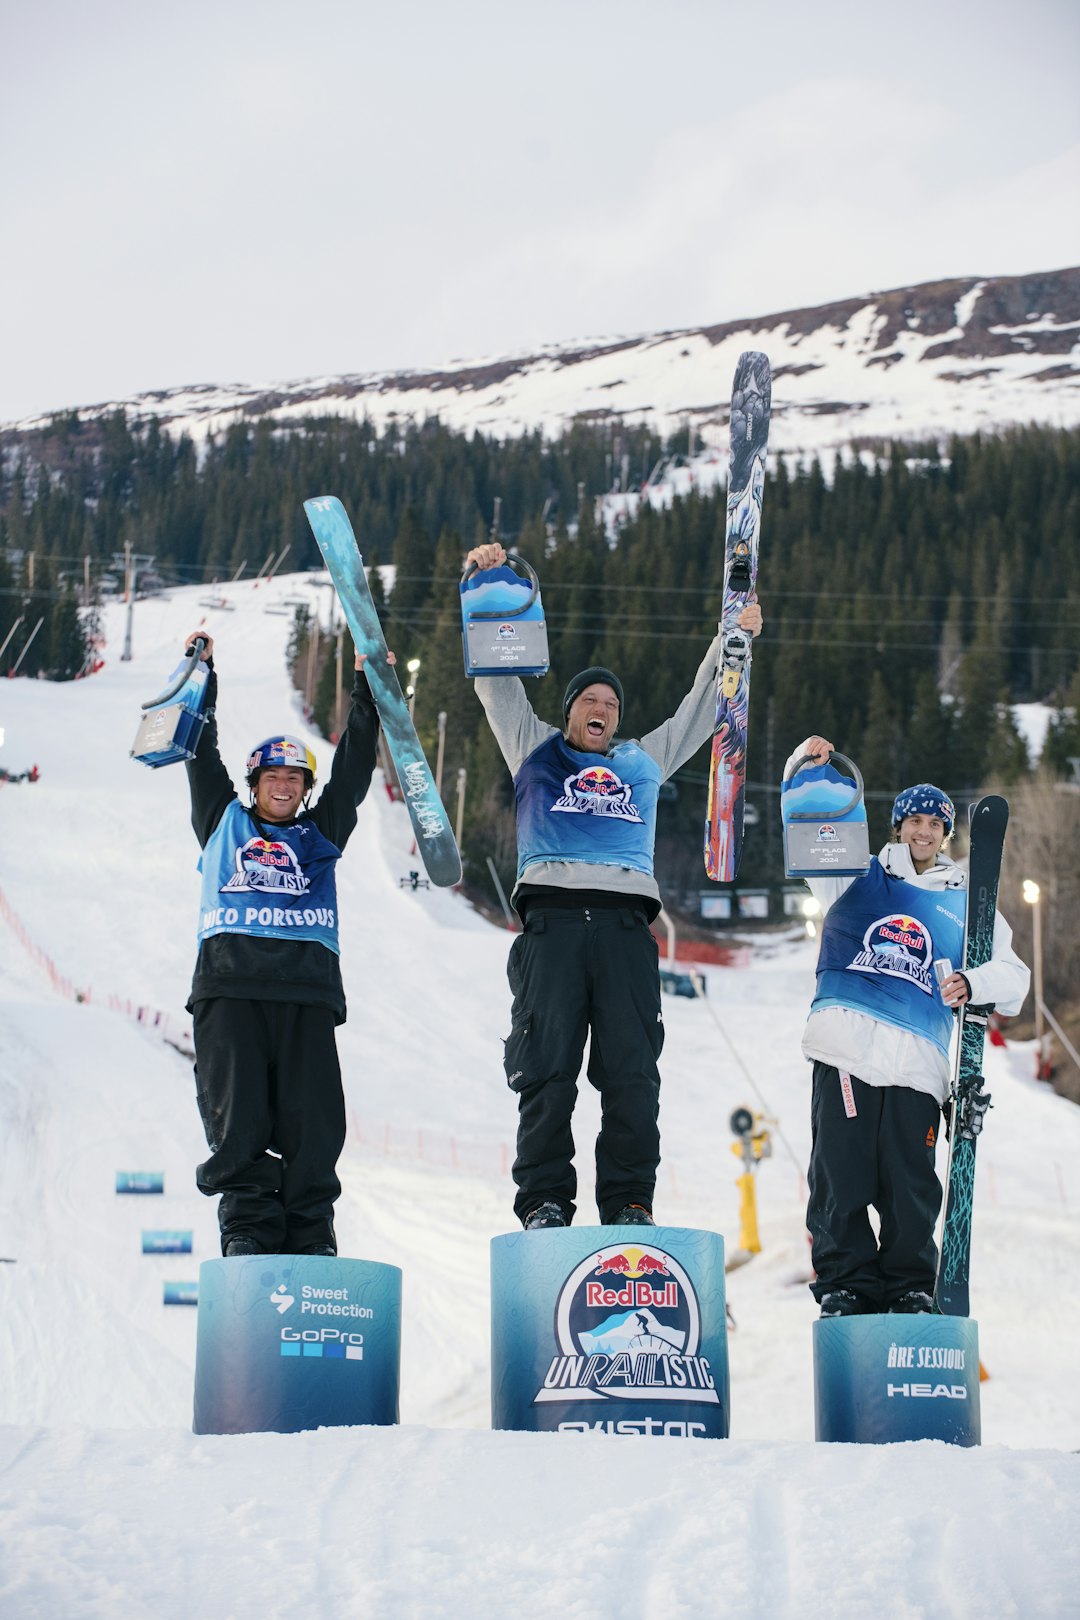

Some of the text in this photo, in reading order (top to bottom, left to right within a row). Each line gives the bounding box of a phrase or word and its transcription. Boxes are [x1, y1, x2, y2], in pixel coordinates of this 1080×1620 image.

[556, 796, 640, 817] UNRAILISTIC
[267, 852, 289, 866] Bull
[227, 870, 310, 891] UNRAILISTIC
[203, 907, 335, 931] NICO PORTEOUS
[879, 926, 924, 950] Red Bull
[852, 950, 933, 989] UNRAILISTIC
[301, 1285, 348, 1301] Sweet
[586, 1280, 678, 1308] Red Bull
[301, 1302, 374, 1319] Protection
[280, 1327, 364, 1345] GoPro
[916, 1346, 966, 1370] SESSIONS
[543, 1352, 715, 1389] UNRAILISTIC
[887, 1383, 967, 1399] HEAD
